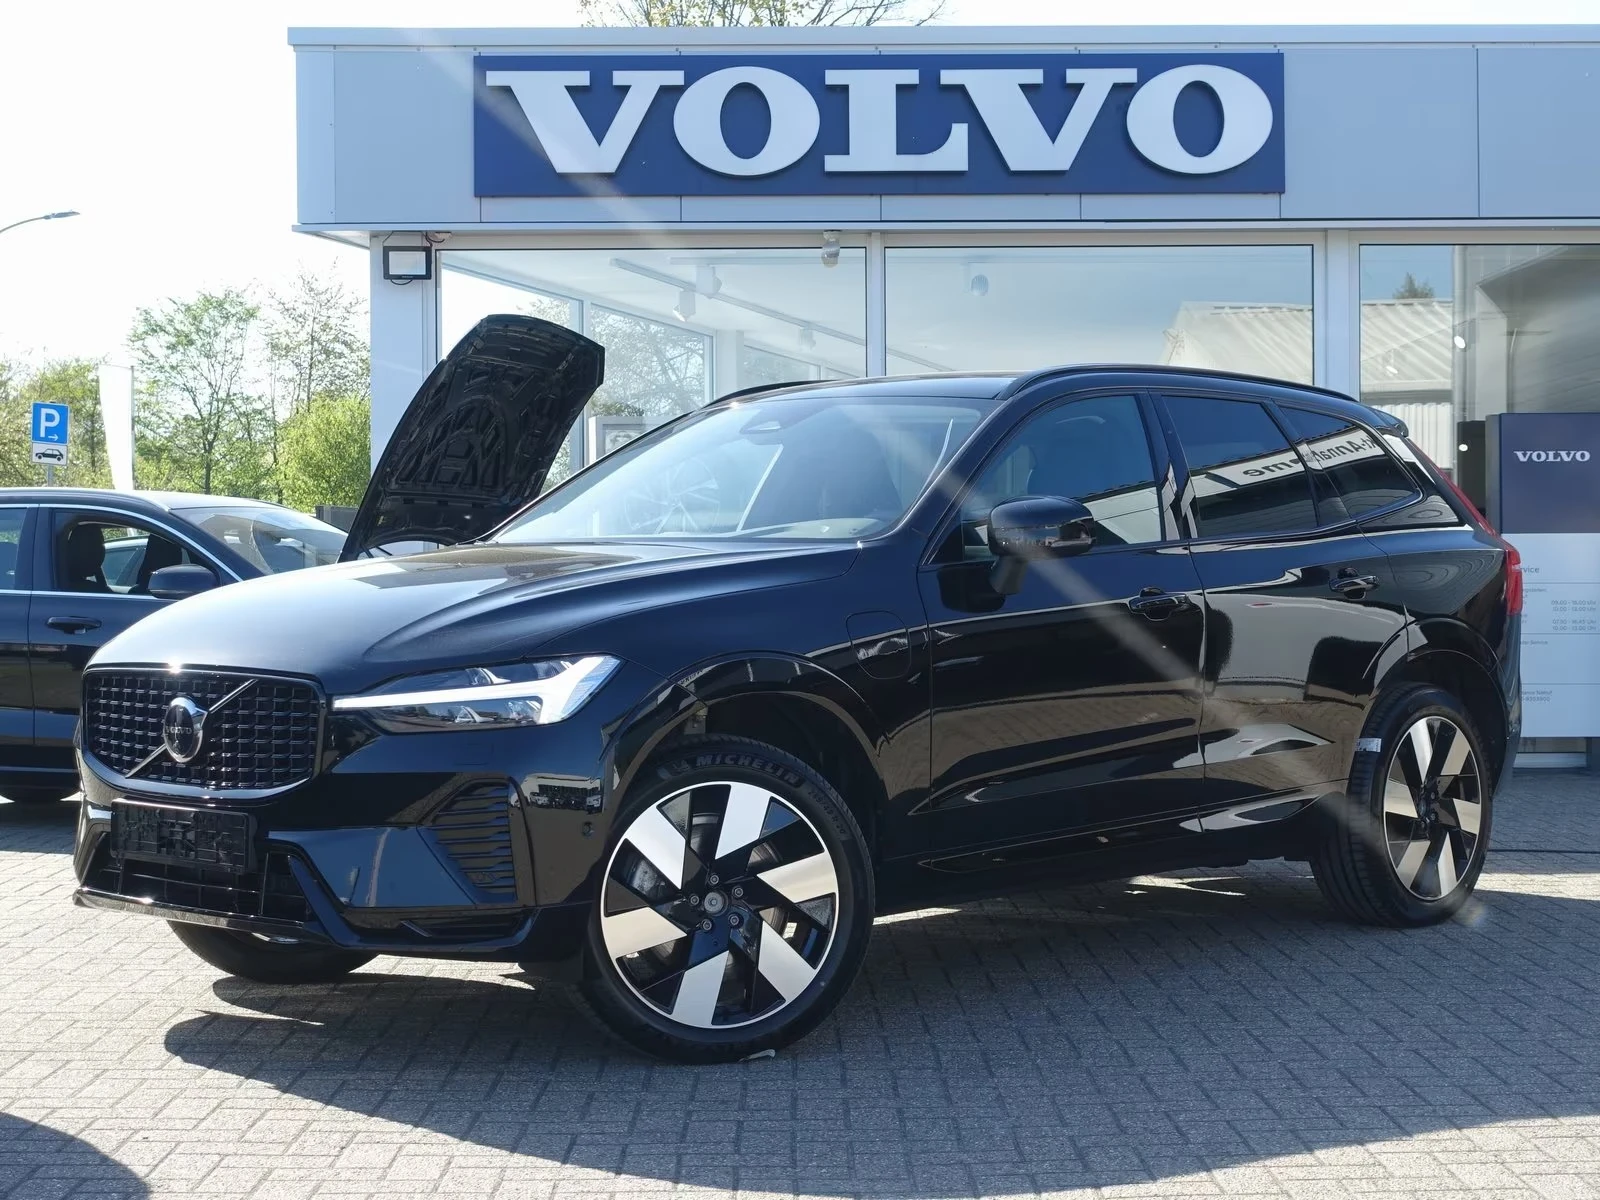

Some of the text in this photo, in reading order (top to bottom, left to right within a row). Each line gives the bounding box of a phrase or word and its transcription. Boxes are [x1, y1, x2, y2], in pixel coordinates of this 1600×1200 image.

[485, 64, 1274, 177] VOLVO
[40, 407, 60, 438] P
[1513, 450, 1591, 462] VOLVO
[695, 753, 800, 786] MICHELIN
